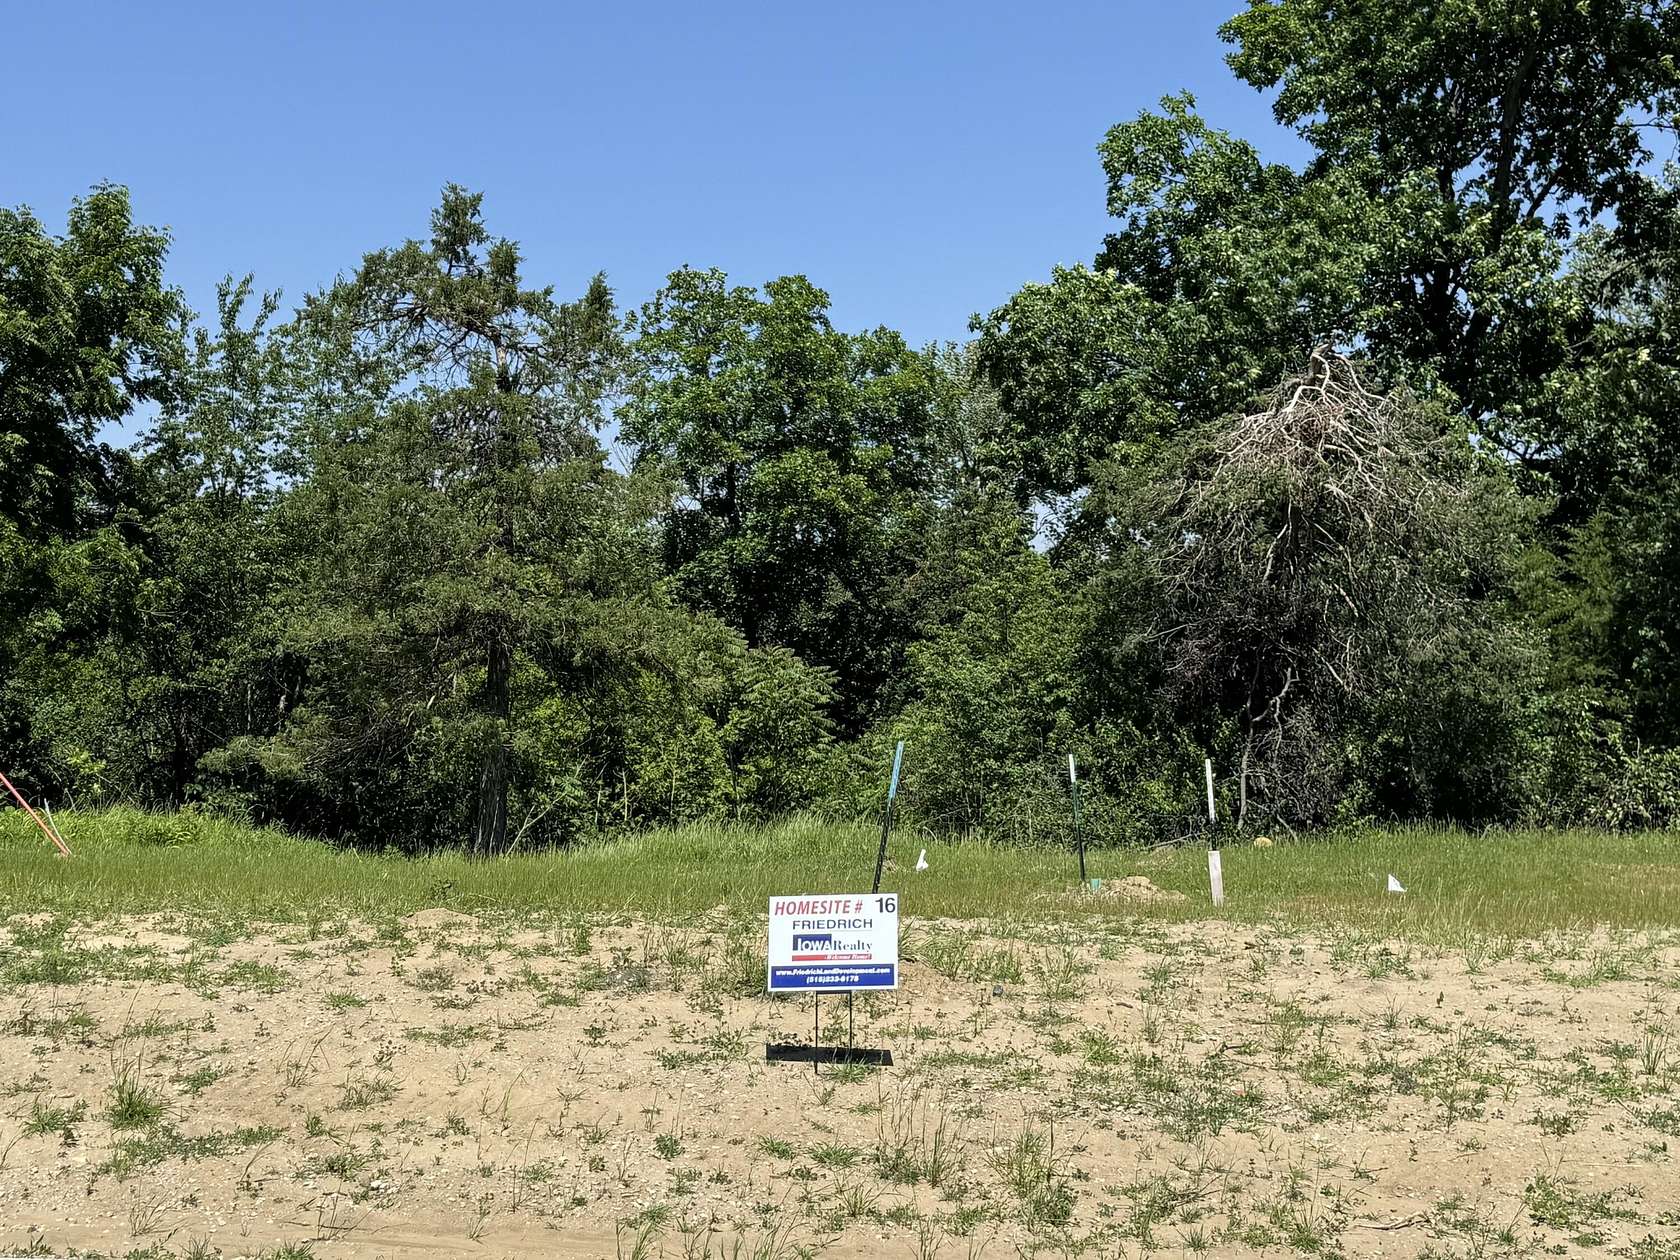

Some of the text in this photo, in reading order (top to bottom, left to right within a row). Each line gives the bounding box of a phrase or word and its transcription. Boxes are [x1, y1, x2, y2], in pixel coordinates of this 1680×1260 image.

[774, 897, 896, 916] HOMESITE # 16
[792, 918, 873, 930] FRIEDRICH
[833, 940, 873, 953] Realty
